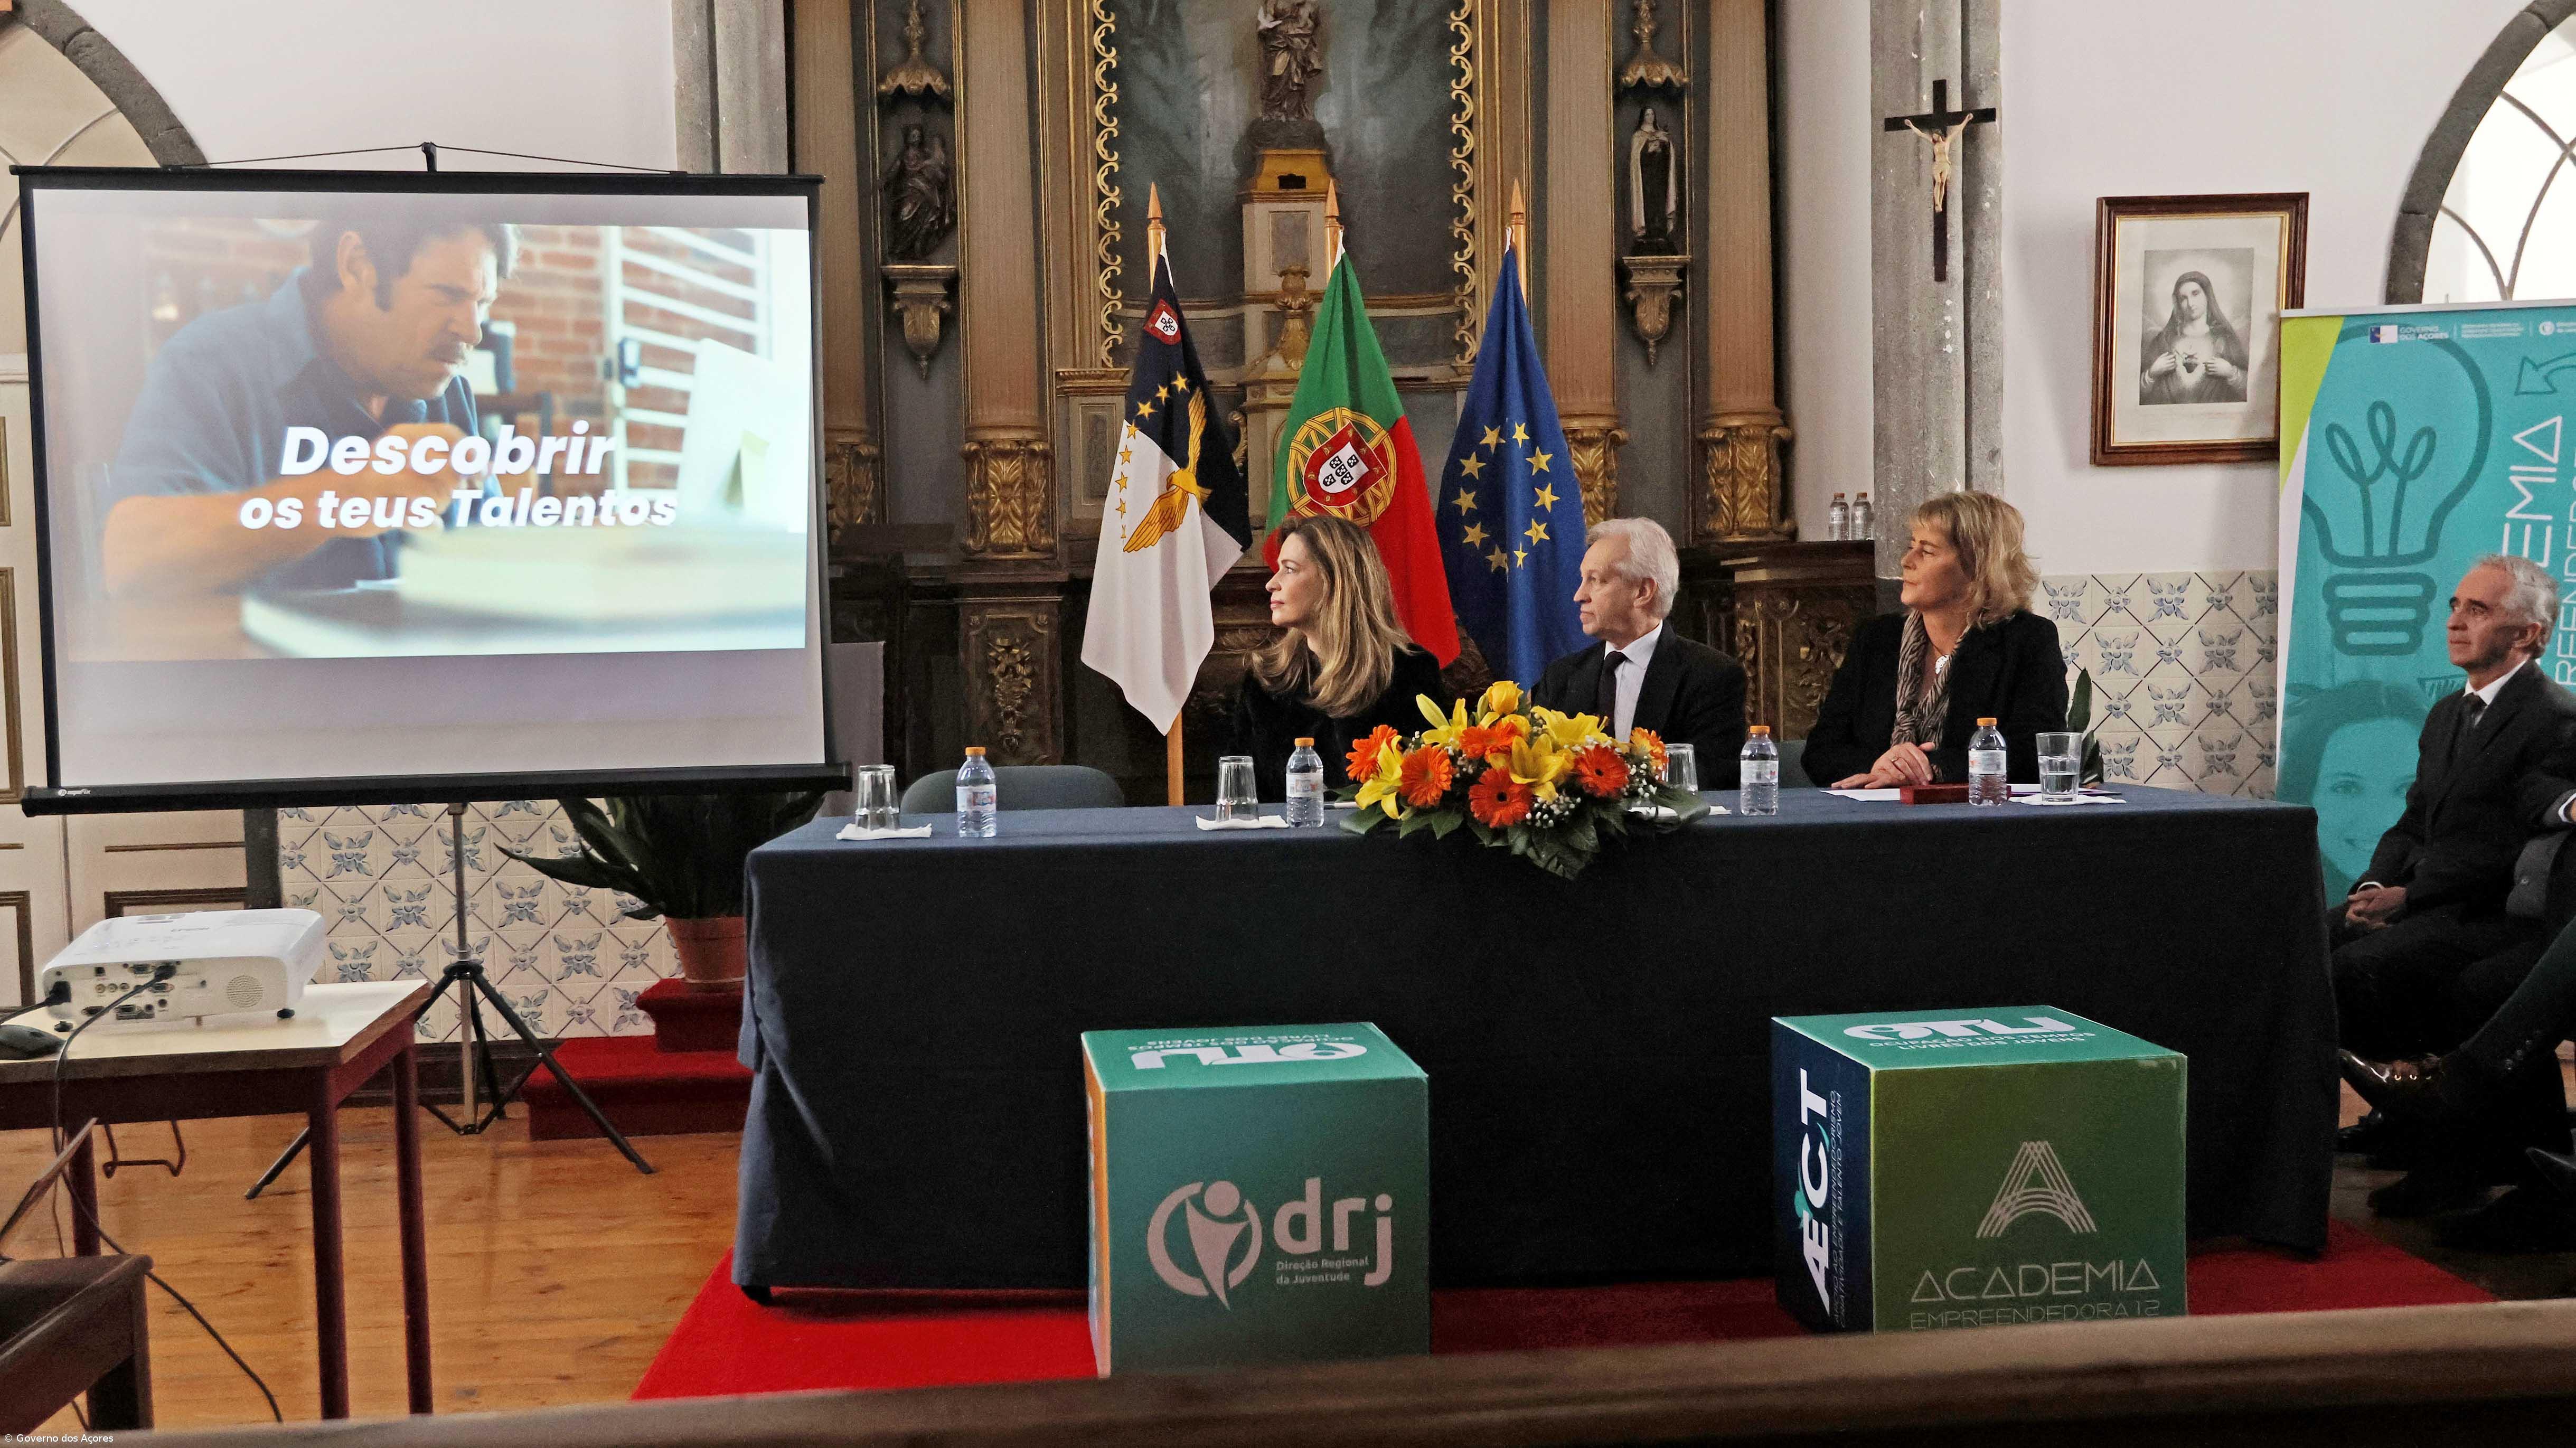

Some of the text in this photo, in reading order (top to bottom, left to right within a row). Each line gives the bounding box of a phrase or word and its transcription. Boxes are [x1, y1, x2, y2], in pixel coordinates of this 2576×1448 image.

[280, 420, 617, 476] Descobrir
[239, 487, 678, 530] os teus Talentos
[2502, 415, 2562, 568] EMIA
[1273, 1177, 1393, 1286] drj
[1276, 1256, 1369, 1271] Direção Regional
[1276, 1272, 1350, 1284] da Juventude
[1911, 1258, 2160, 1302] ACADEMIA
[1911, 1302, 2129, 1330] EMPREENDEDORA
